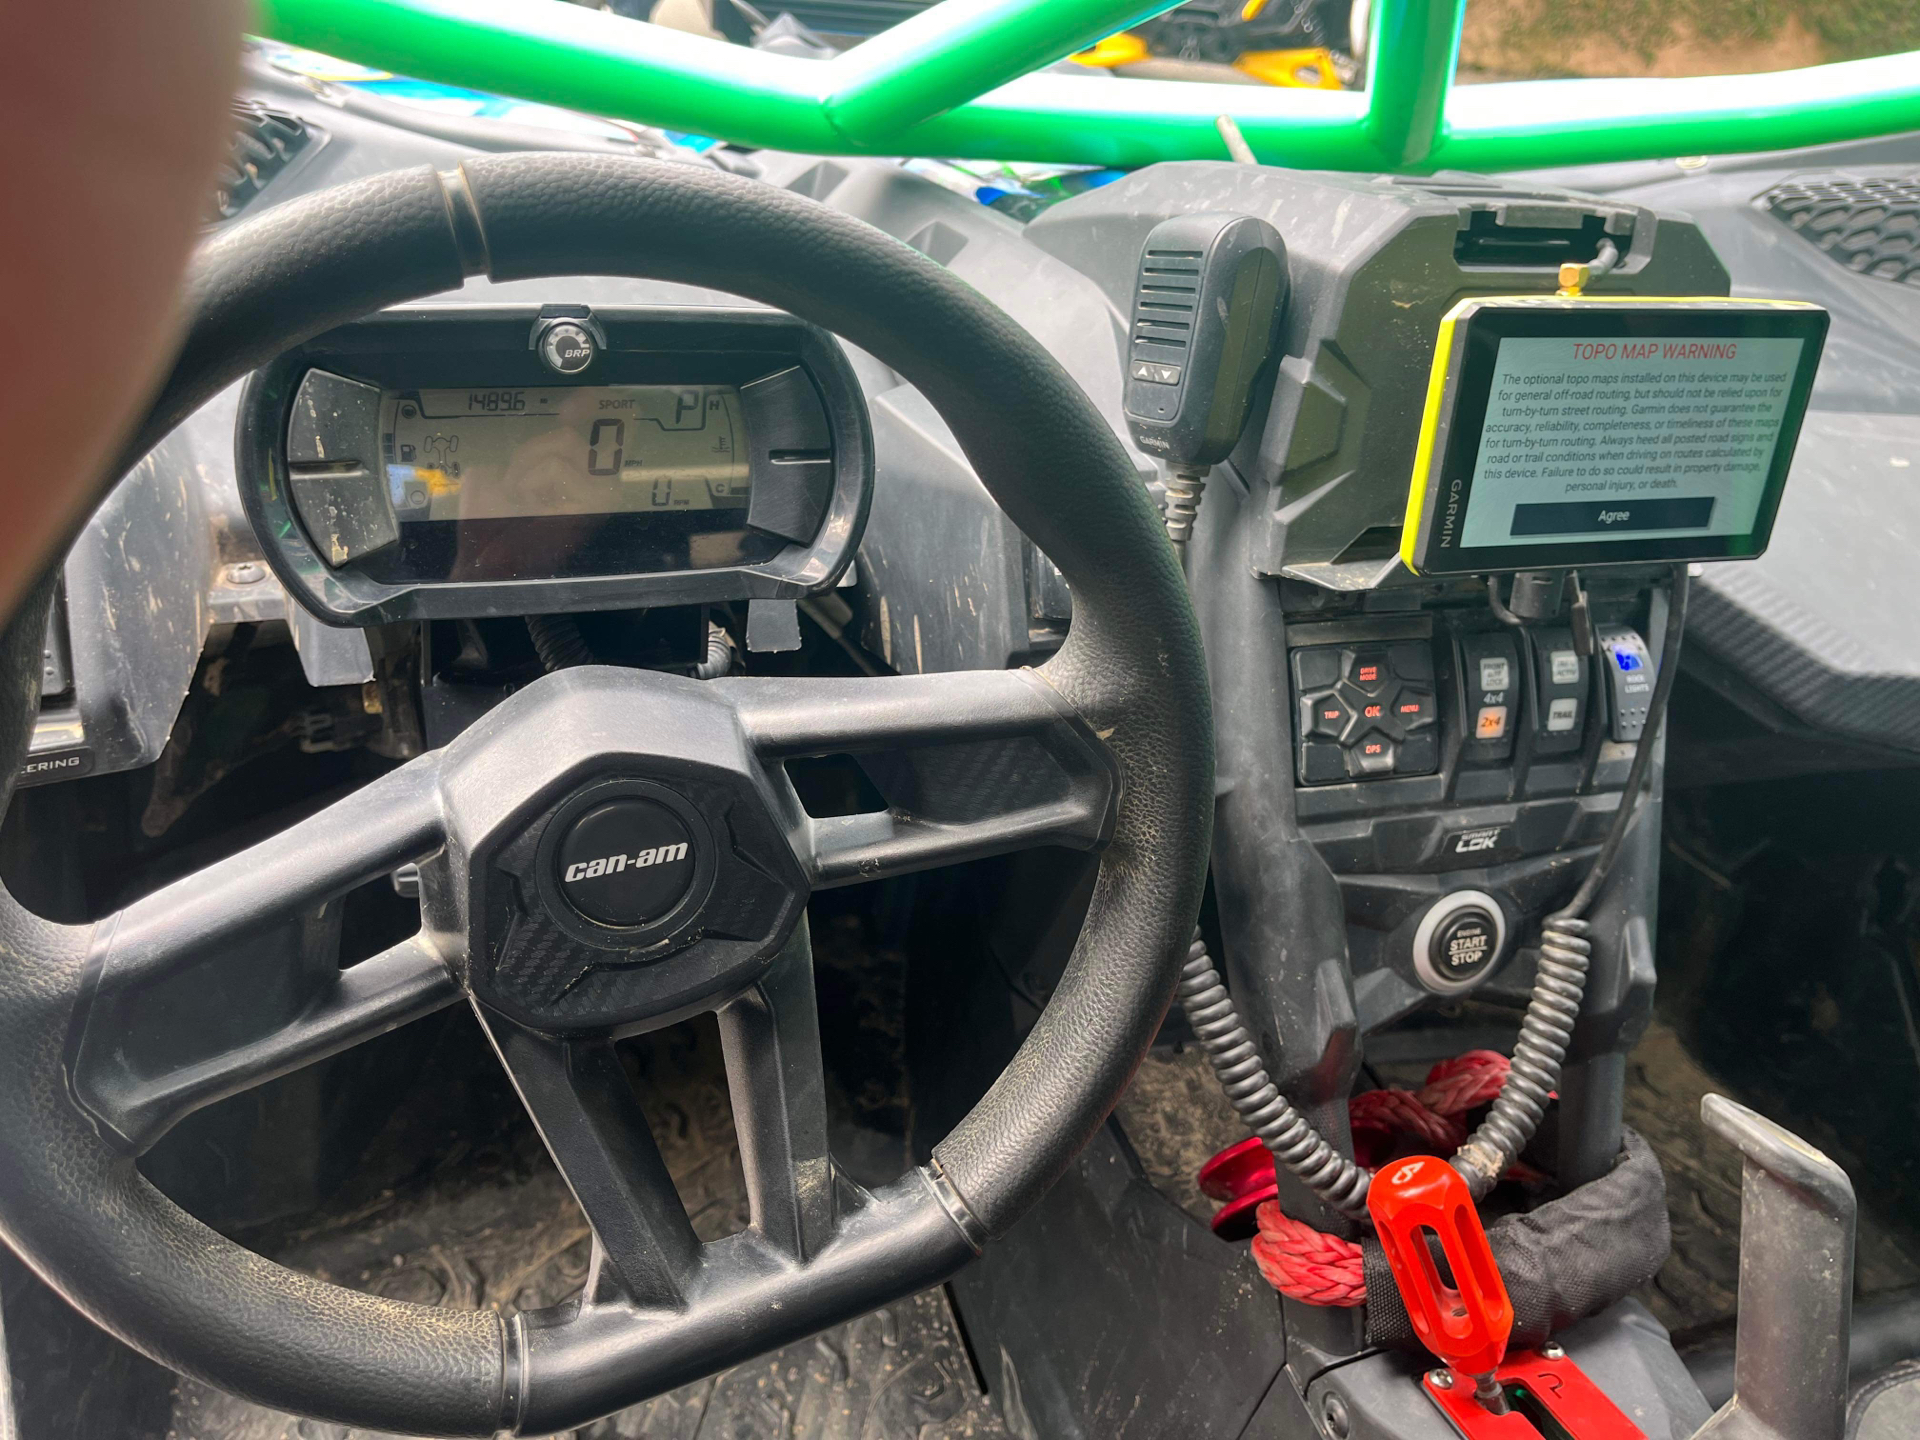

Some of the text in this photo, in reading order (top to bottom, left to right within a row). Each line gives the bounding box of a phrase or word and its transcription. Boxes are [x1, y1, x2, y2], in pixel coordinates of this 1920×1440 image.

[565, 349, 590, 358] BRP
[1573, 343, 1738, 360] TOPO MAP WARNING
[1502, 372, 1787, 387] The optional topo maps installed on this device may be used
[1498, 386, 1783, 403] for general off-road routing, but should not be relied upon for
[598, 399, 635, 410] SPORT
[676, 390, 699, 424] P
[709, 400, 720, 411] H
[1502, 403, 1773, 418] turn-by-turn street routing. Garmin does not guarantee the
[1485, 417, 1780, 435] accuracy, reliability, completeness, or timeliness of these maps
[588, 418, 625, 476] 0
[1139, 436, 1170, 450] GARMIN
[1485, 432, 1774, 450] for turn-by-turn routing. Always heed all posted road signs and
[1487, 447, 1765, 464] road or trail conditions when driving on routes calculated by
[1484, 468, 1502, 479] this
[1504, 467, 1538, 479] device.
[1541, 466, 1574, 478] Failure
[1576, 467, 1587, 477] to
[1588, 466, 1601, 476] do
[1603, 467, 1615, 476] so
[1616, 464, 1643, 475] could
[1644, 463, 1672, 474] result
[1673, 463, 1682, 473] in
[1683, 463, 1721, 475] property
[715, 483, 725, 493] C
[1565, 478, 1678, 494] personal injury, or death.
[1440, 478, 1462, 548] GARMIN
[1598, 510, 1630, 524] Agree
[1359, 673, 1377, 681] MODE
[1360, 666, 1377, 674] DRIVE
[1624, 683, 1650, 694] LIGHTS
[1483, 692, 1504, 704] 4x4
[1324, 710, 1340, 719] TRIP
[1364, 705, 1381, 718] OK
[1400, 704, 1420, 713] MENU
[1553, 710, 1573, 719] TRAIL
[1481, 717, 1501, 727] 2x4
[1365, 744, 1382, 754] DPS
[564, 842, 689, 883] can-am
[1450, 935, 1488, 951] START
[1451, 951, 1483, 966] STOP
